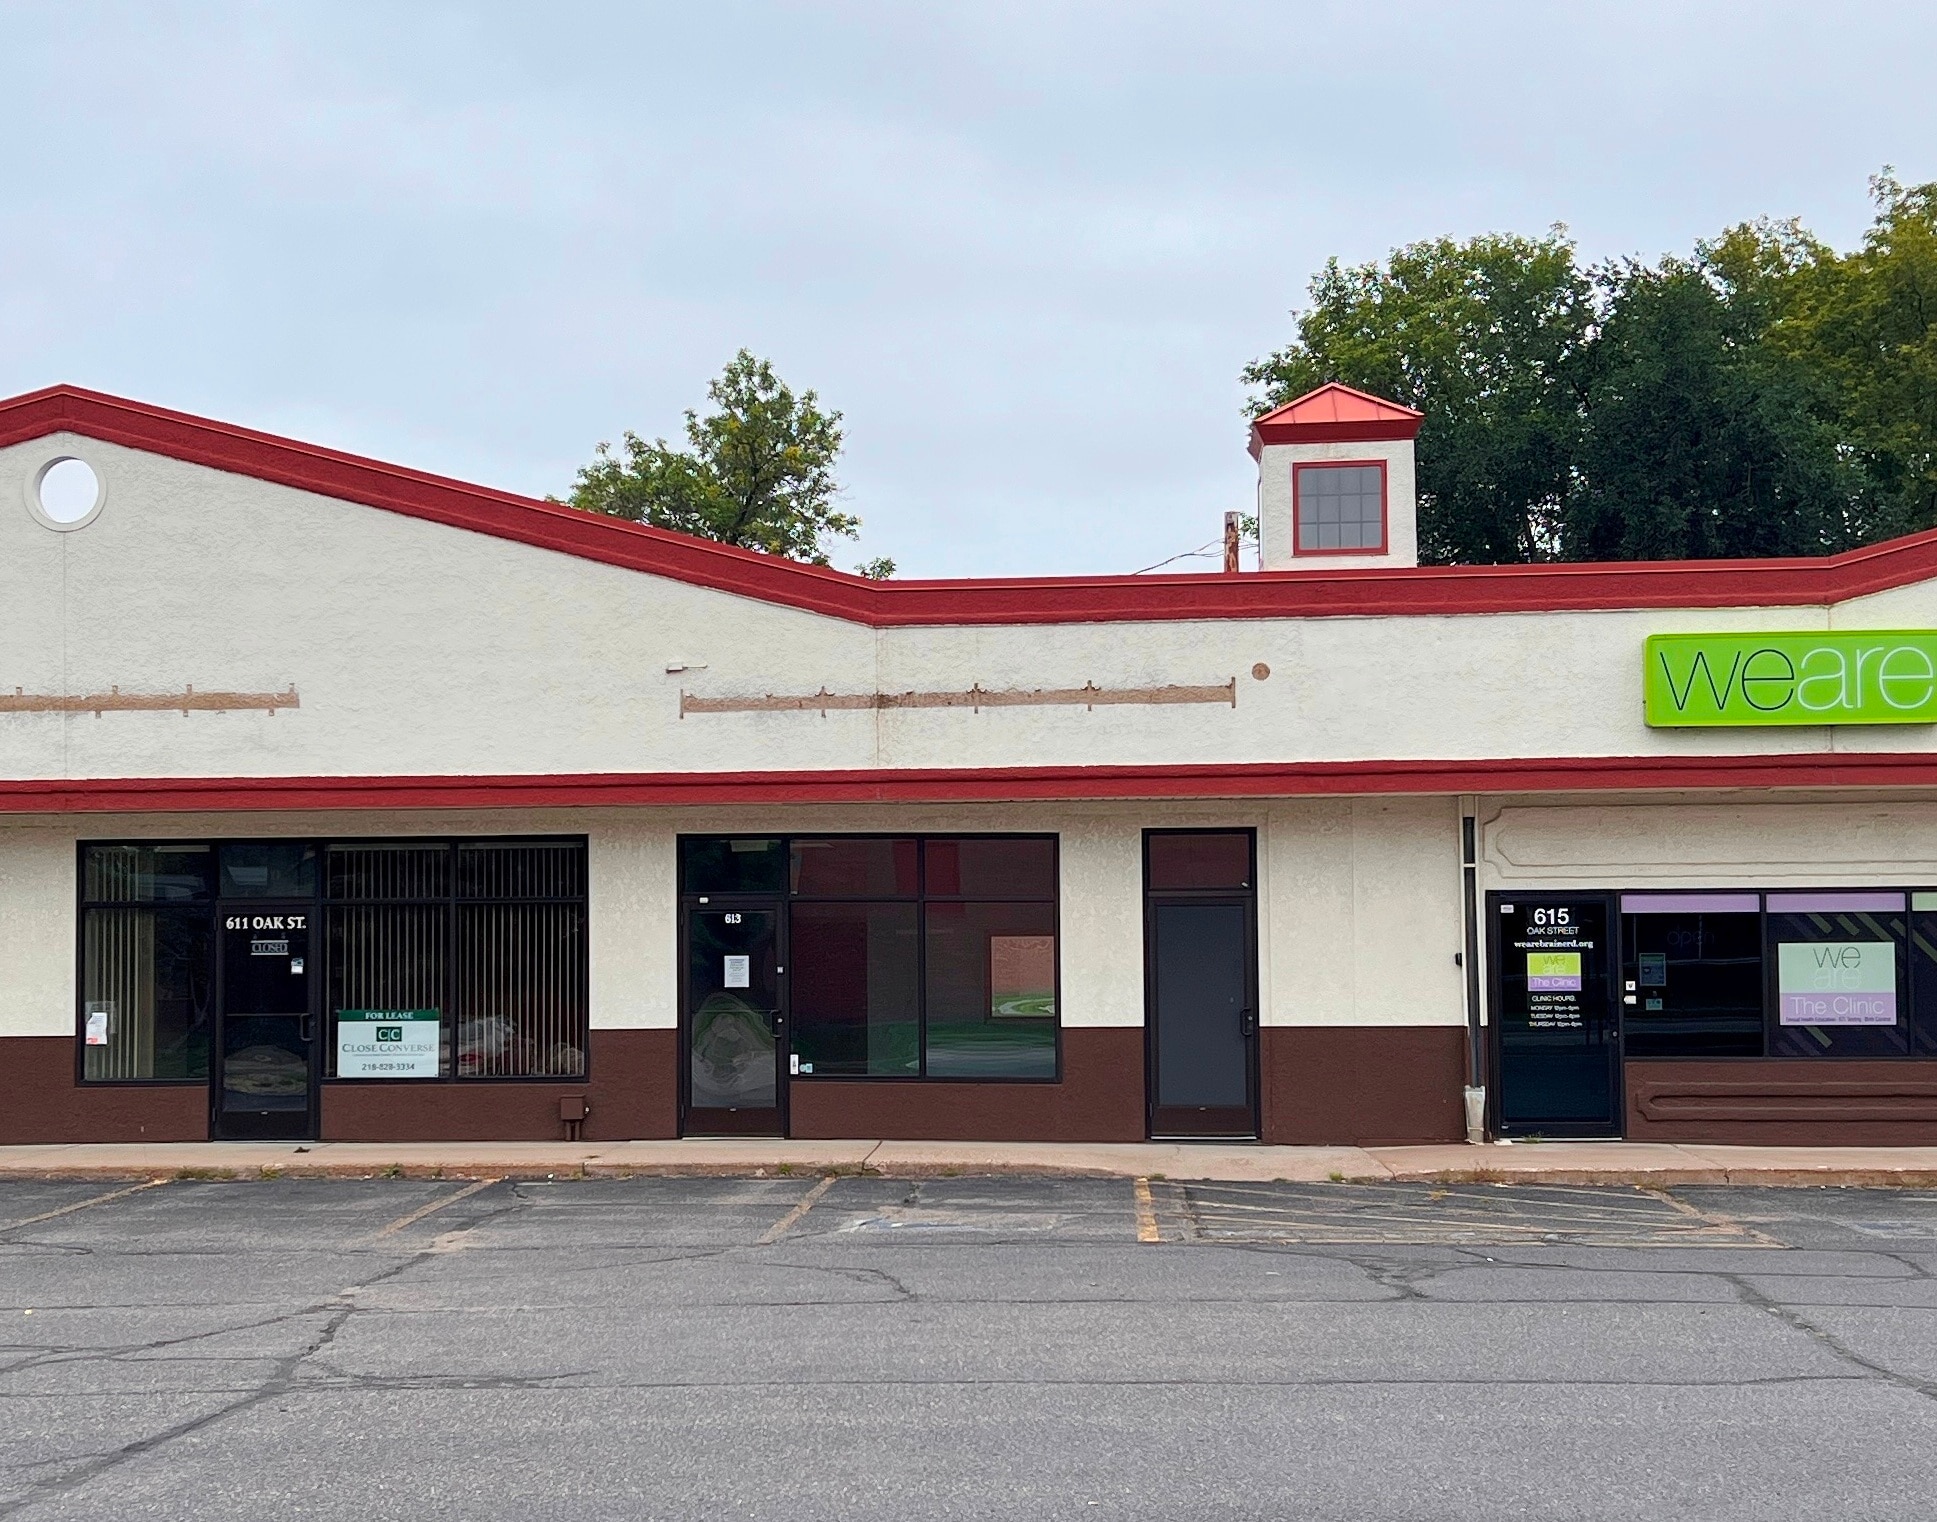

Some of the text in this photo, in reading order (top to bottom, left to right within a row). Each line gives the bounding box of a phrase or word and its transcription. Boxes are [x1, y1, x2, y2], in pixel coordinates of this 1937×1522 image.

[725, 913, 742, 924] 613
[1534, 908, 1569, 925] 615
[226, 917, 307, 929] 611 OAK ST.
[1526, 926, 1580, 935] OAK STREET
[251, 943, 288, 953] CLOSED
[1514, 939, 1594, 949] wearebrainerd.org
[1543, 954, 1566, 965] we
[1813, 946, 1861, 969] we
[1532, 977, 1577, 987] The Clinic
[1813, 967, 1861, 990] are
[1790, 996, 1885, 1015] The Clinic
[365, 1011, 414, 1020] FOR LEASE
